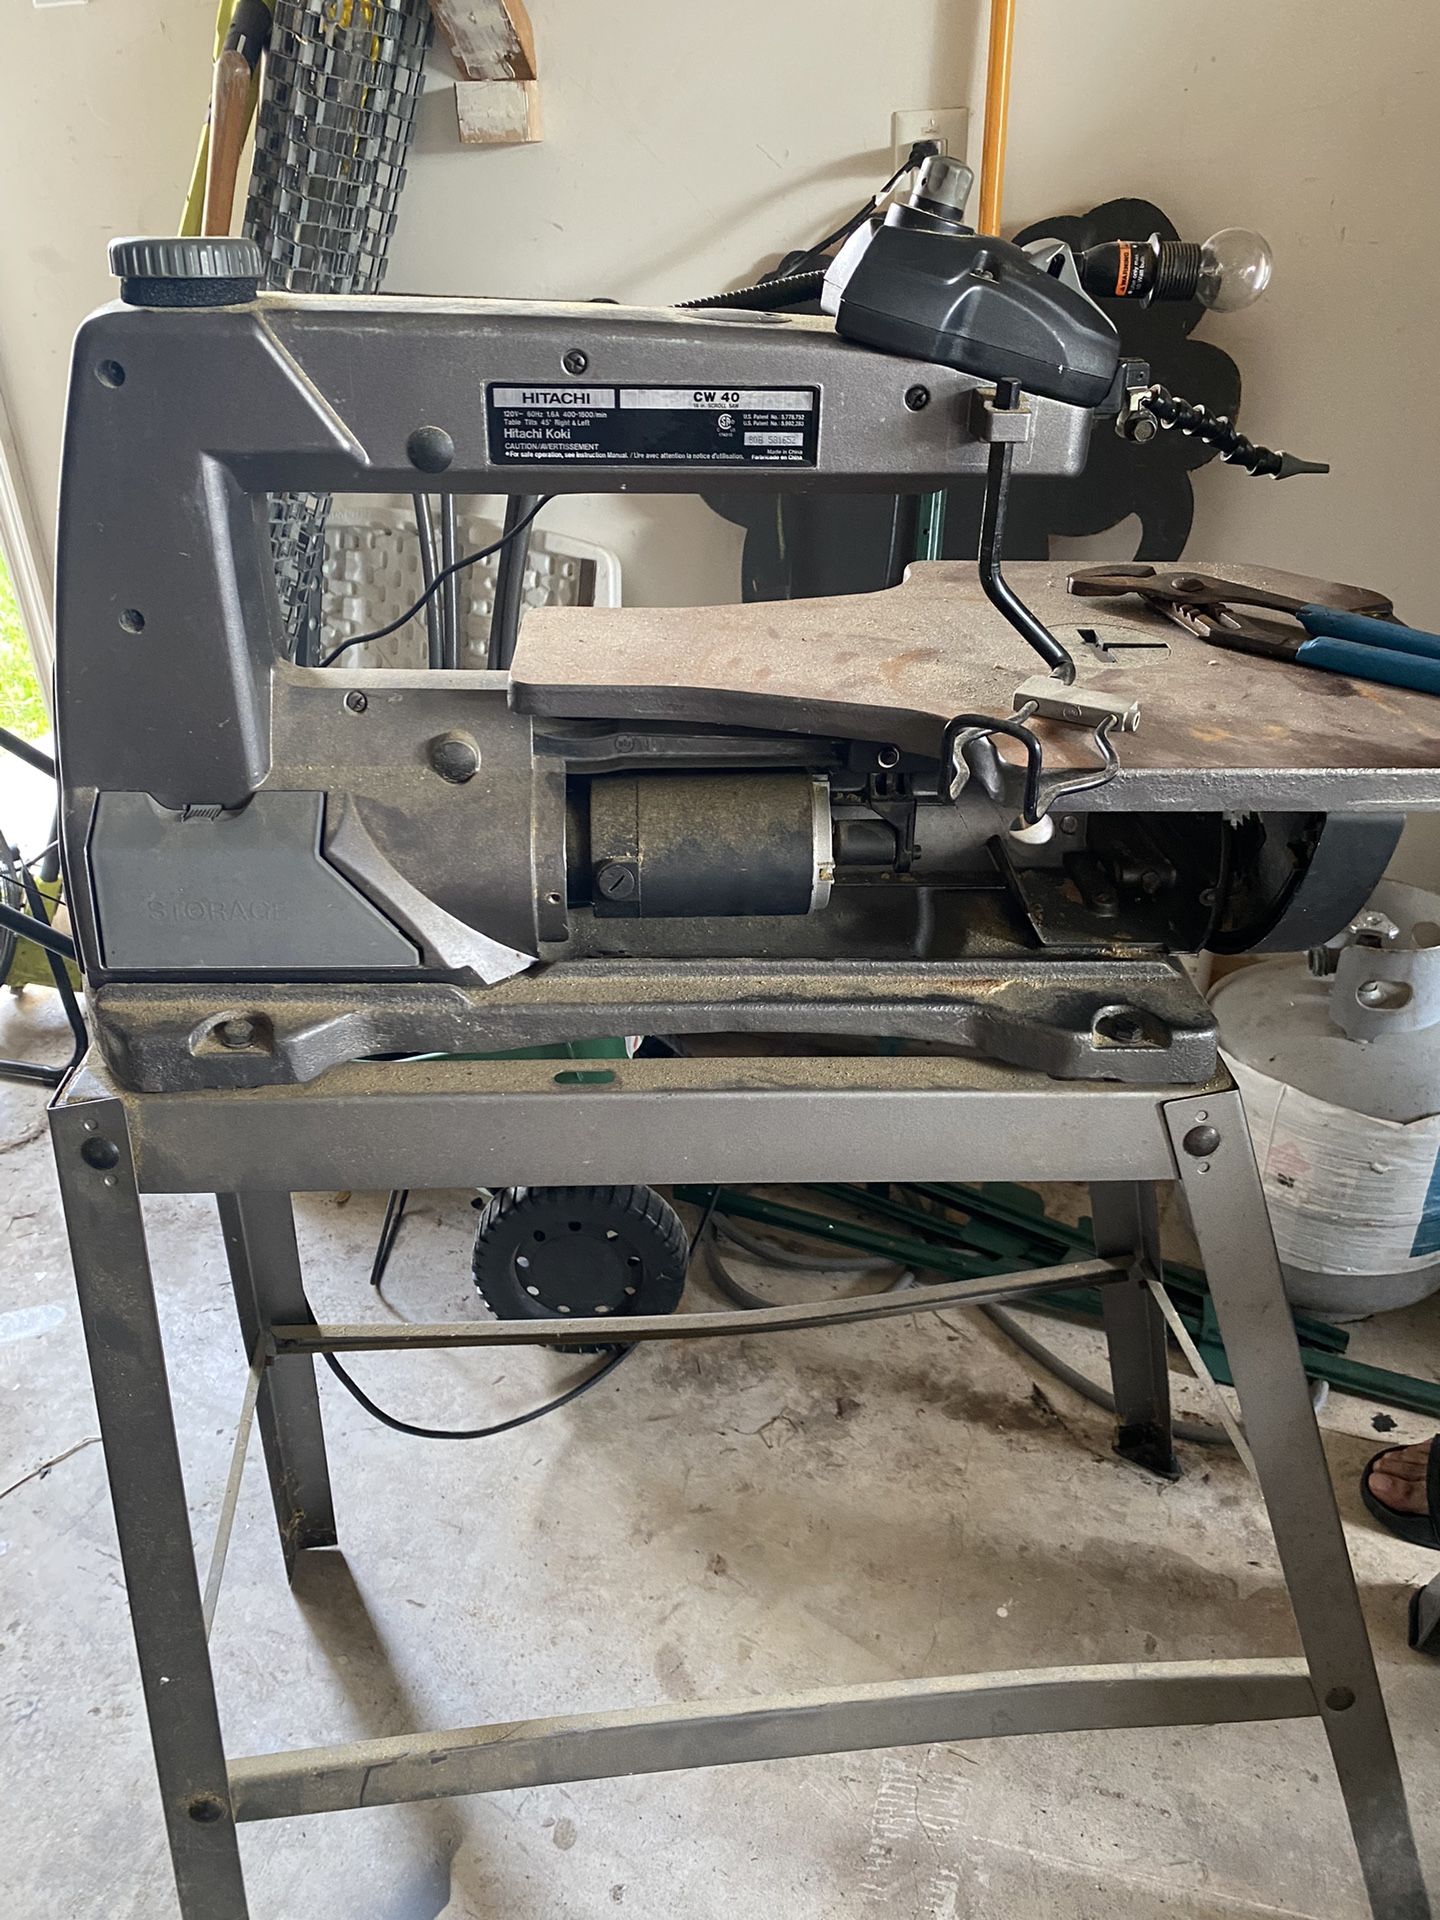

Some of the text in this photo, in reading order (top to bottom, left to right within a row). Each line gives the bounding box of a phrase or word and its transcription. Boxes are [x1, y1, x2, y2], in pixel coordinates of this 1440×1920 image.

[522, 392, 590, 404] HITACHI
[693, 391, 740, 403] CW 40
[503, 418, 521, 426] Table
[554, 419, 571, 428] Right
[577, 419, 591, 427] Left
[503, 428, 571, 439] Hitachi Koki
[504, 442, 600, 451] CAUTION/AVERTISSEMENT
[520, 451, 533, 459] safe
[634, 452, 645, 460] Lire
[147, 900, 286, 922] STORAGE
